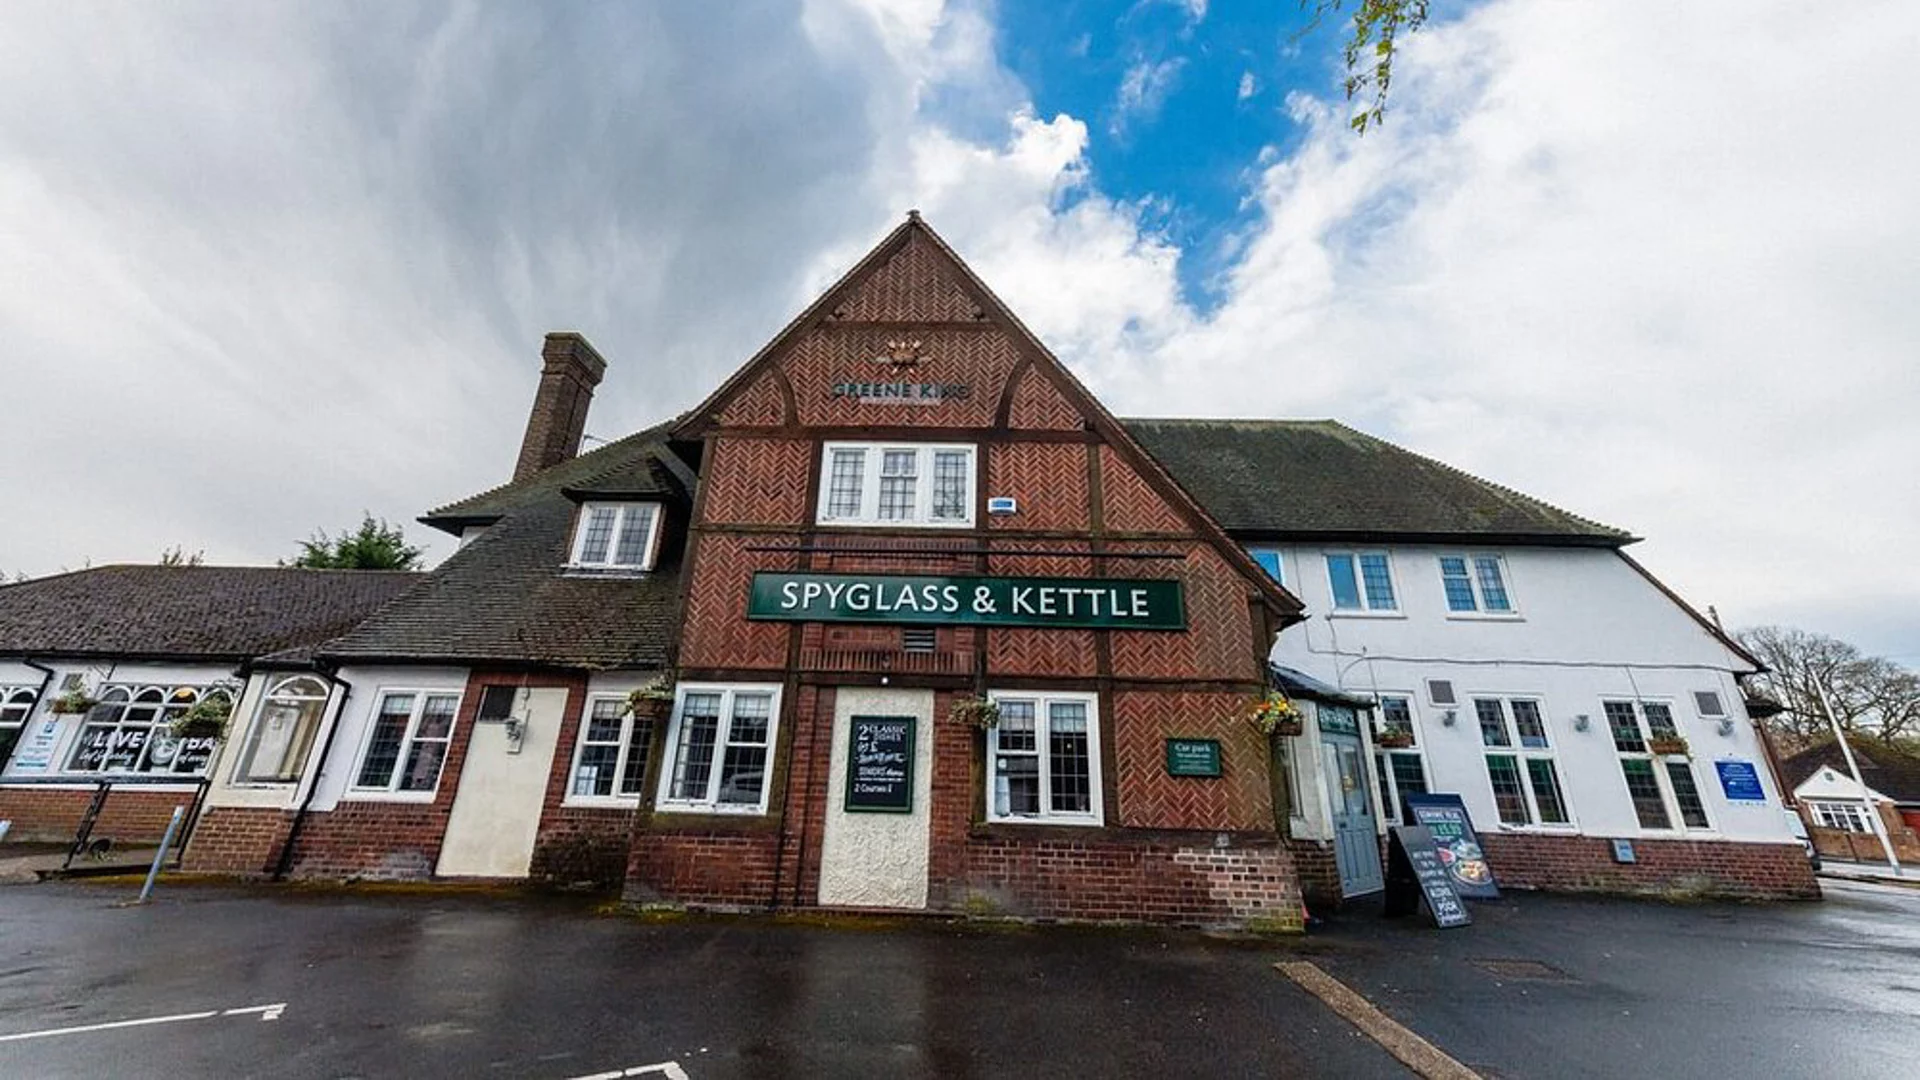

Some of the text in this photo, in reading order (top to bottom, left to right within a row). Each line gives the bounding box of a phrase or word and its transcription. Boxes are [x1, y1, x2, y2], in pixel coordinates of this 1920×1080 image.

[831, 383, 912, 399] GREENE
[781, 580, 1150, 617] SPYGLASS & KETTLE
[858, 724, 869, 741] 2
